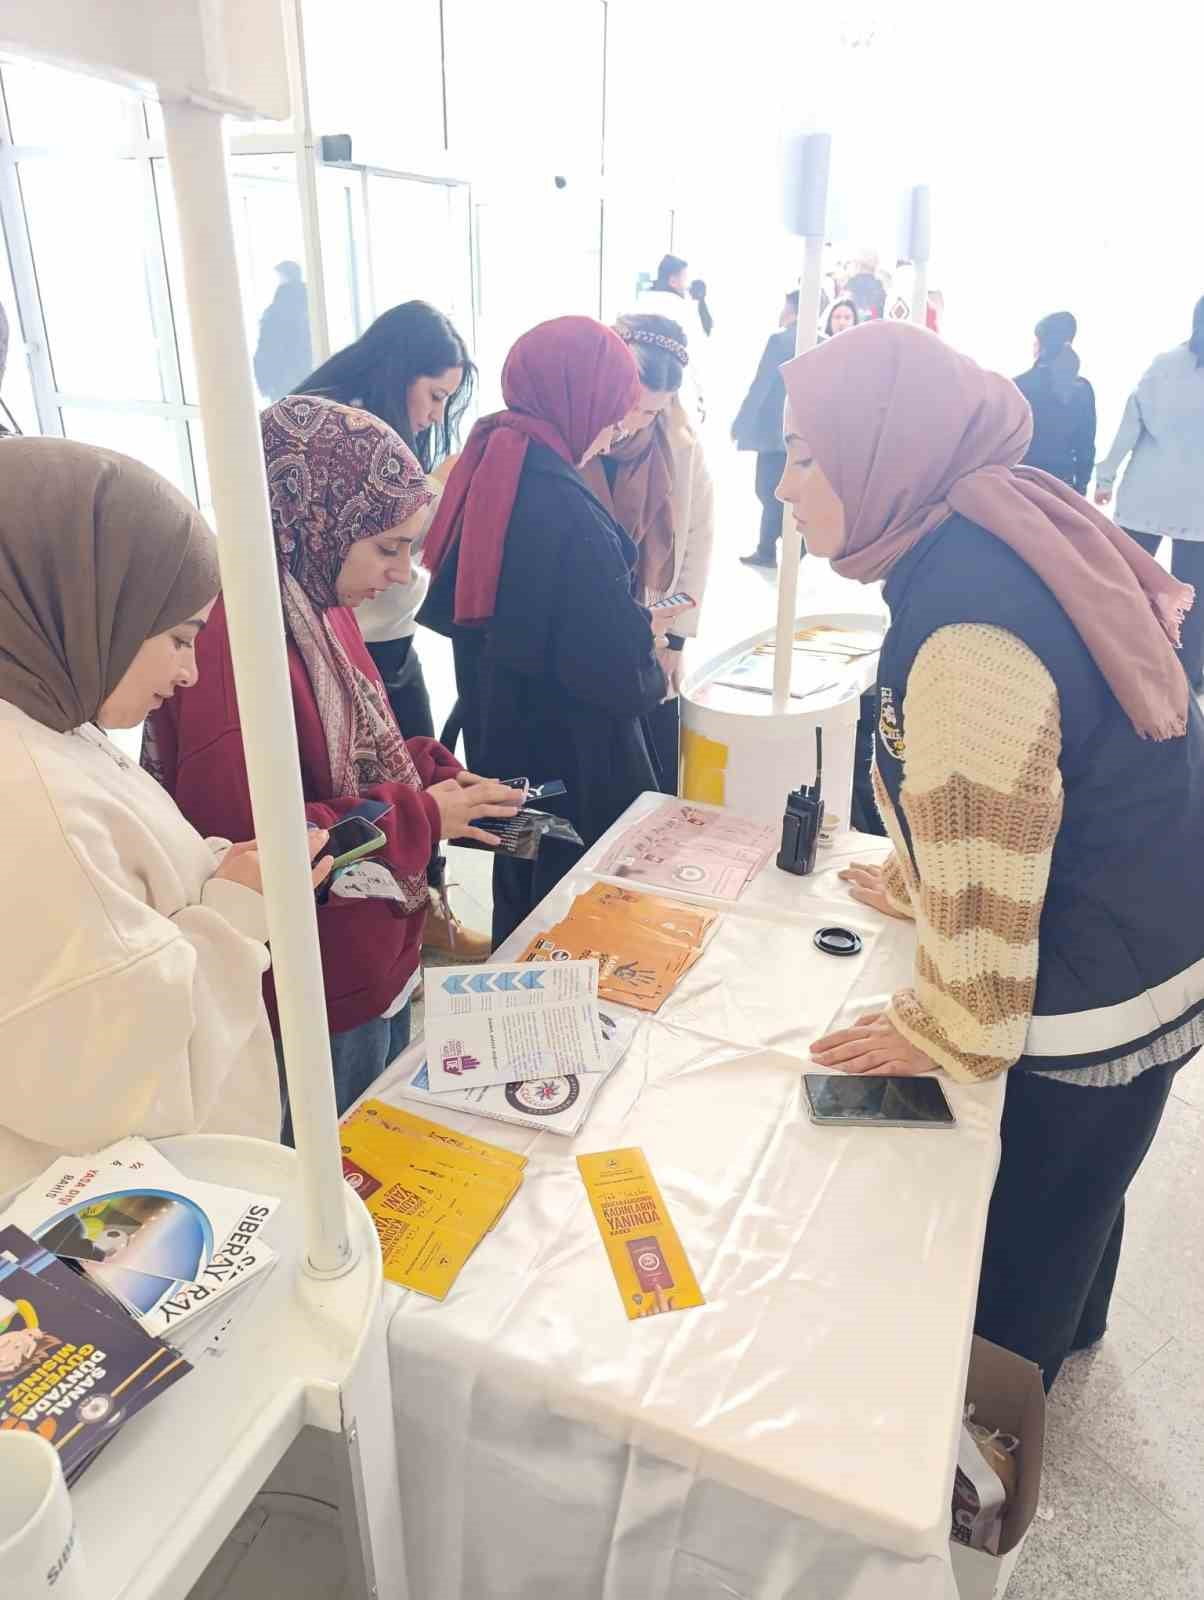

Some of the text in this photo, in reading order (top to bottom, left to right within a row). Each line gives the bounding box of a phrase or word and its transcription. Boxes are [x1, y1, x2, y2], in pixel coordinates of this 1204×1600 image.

[607, 1210, 661, 1230] YANINDA
[21, 1350, 107, 1420] DÜNYADA
[46, 1367, 106, 1416] SANAL
